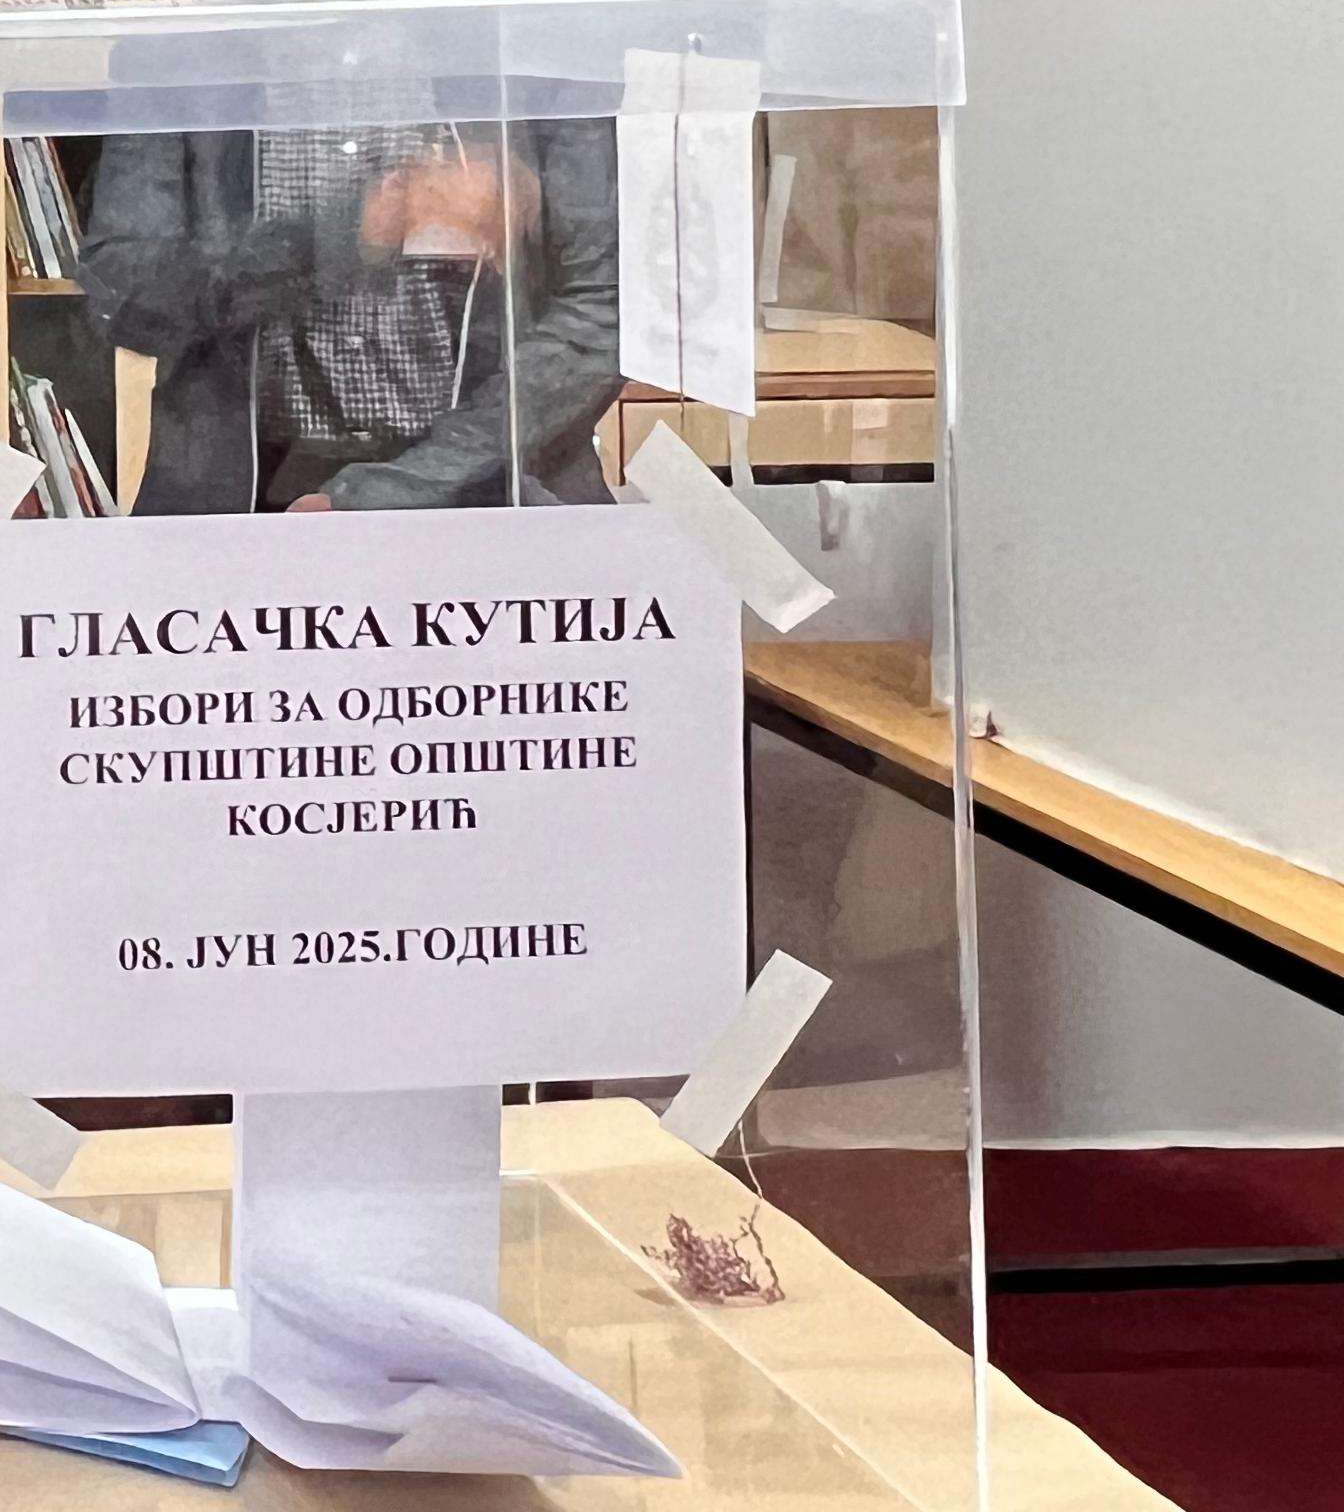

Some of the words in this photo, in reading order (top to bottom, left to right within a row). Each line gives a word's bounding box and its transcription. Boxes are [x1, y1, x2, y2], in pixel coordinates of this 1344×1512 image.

[20, 605, 393, 658] ГЛАСАЧКА
[411, 596, 677, 647] КУТИЈА
[70, 691, 254, 729] ИЗБОРИ
[269, 689, 324, 723] ЗА
[338, 680, 629, 727] ОДБОРНИКЕ
[59, 744, 376, 785] СКУПШТИНЕ
[390, 736, 637, 775] ОПШТИНЕ
[228, 797, 477, 836] КОСЈЕРИЋ
[118, 937, 174, 971] 08.
[186, 933, 276, 969] ЈУН
